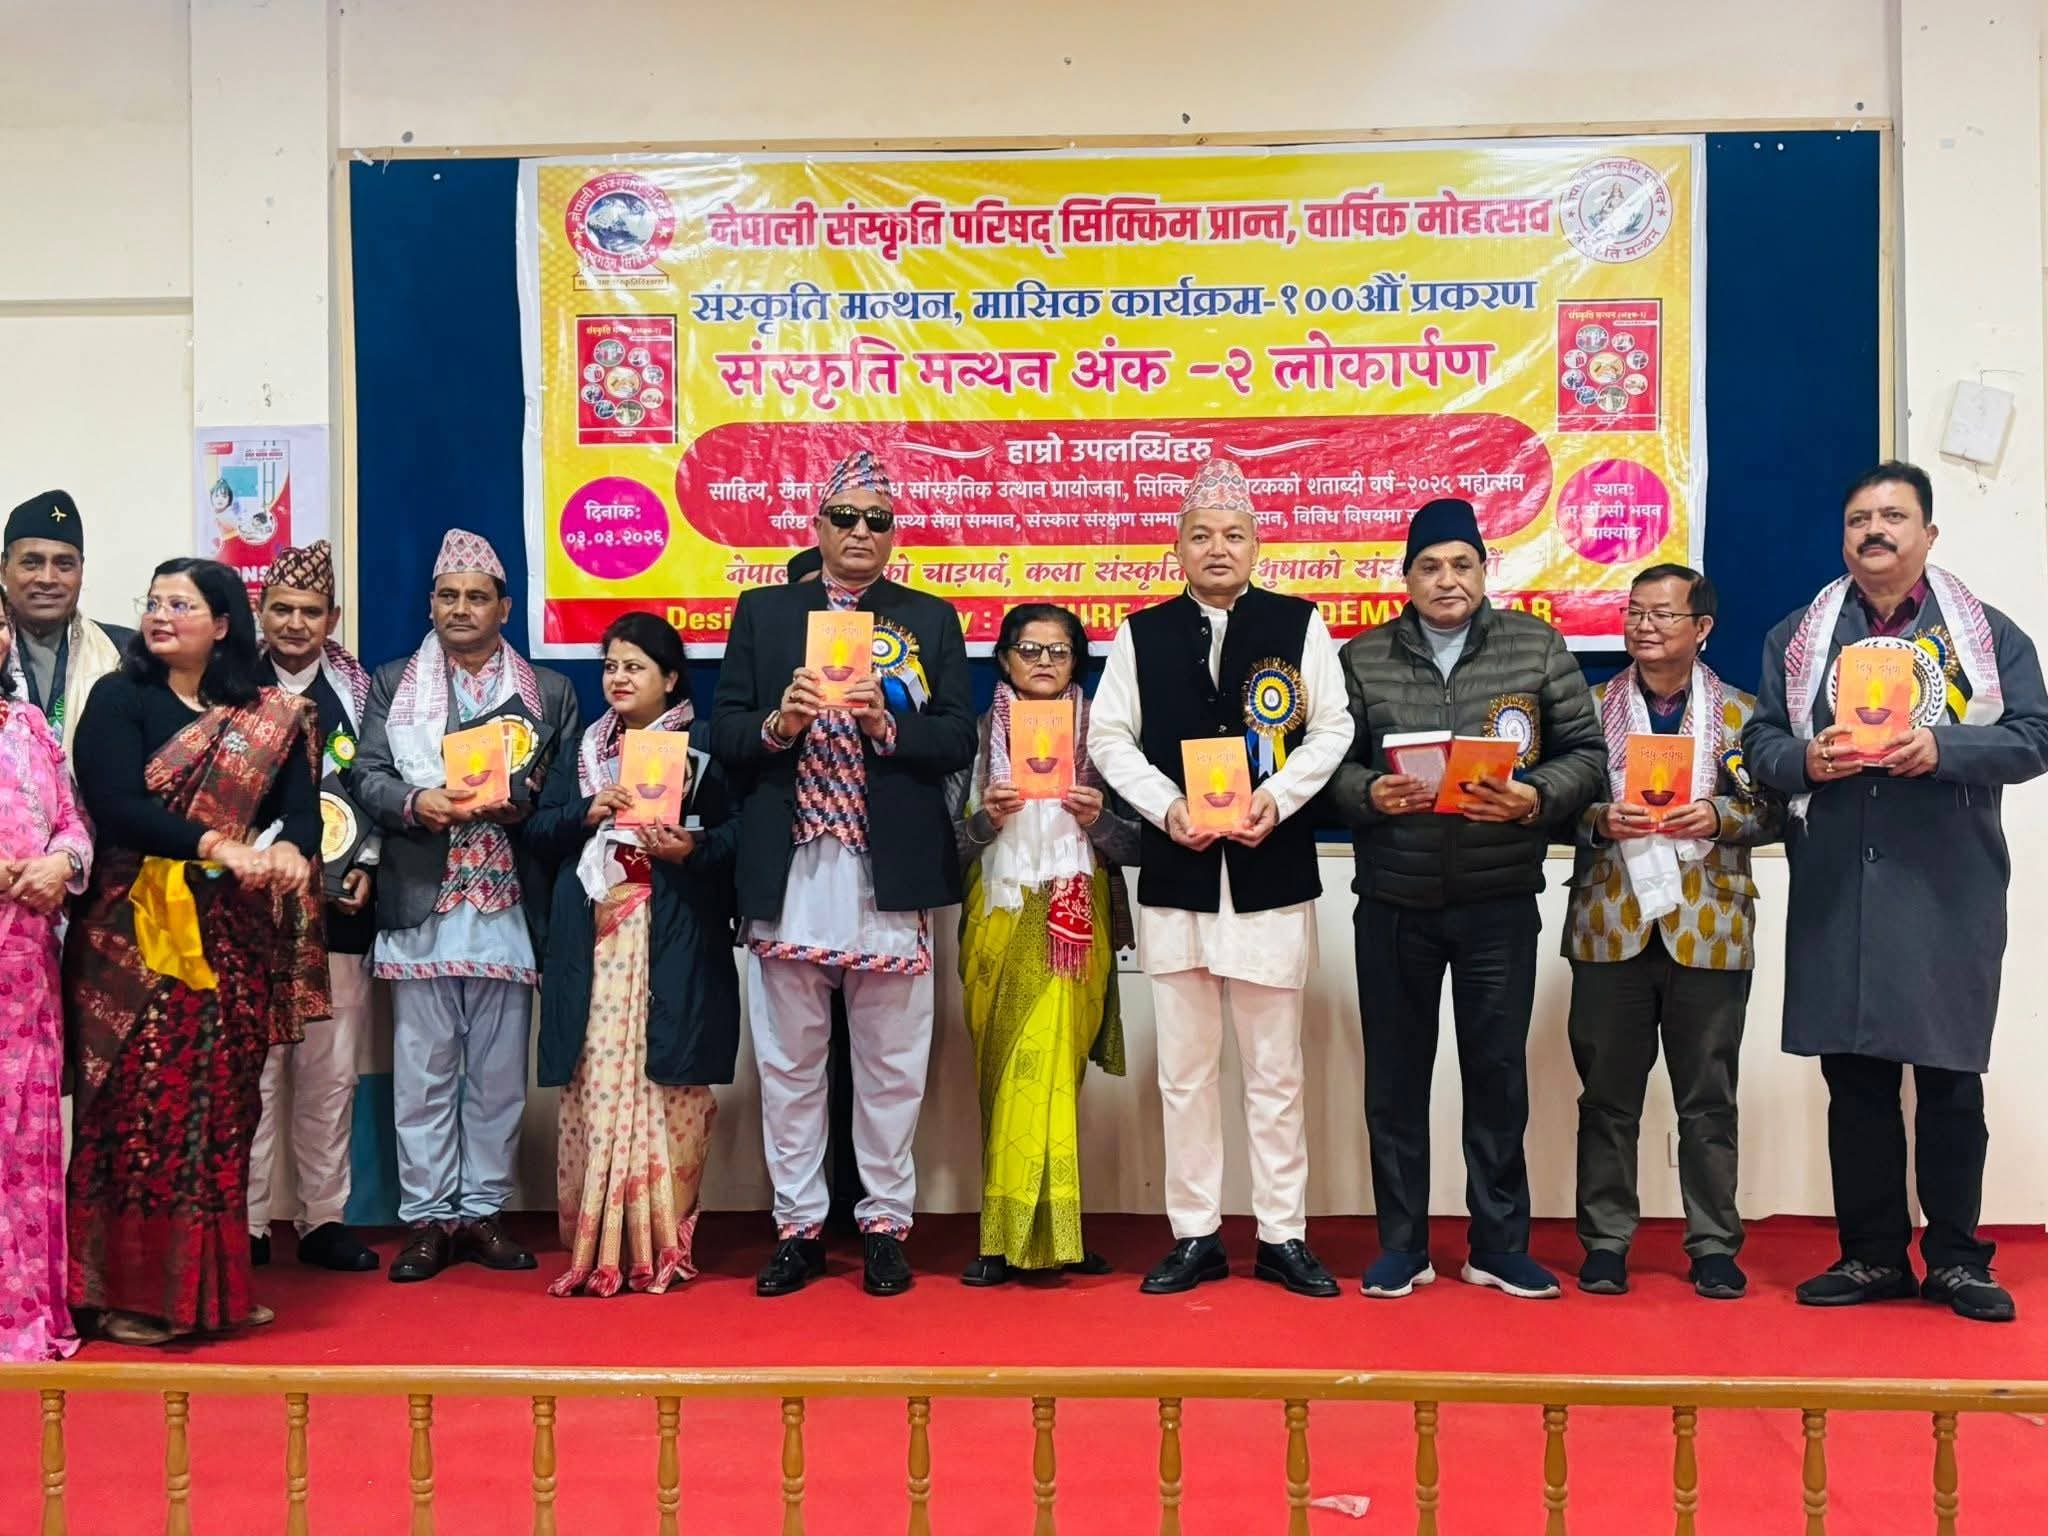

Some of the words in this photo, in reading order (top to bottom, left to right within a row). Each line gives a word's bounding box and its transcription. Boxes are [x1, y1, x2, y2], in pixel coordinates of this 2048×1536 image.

[707, 202, 815, 246] नेपाली
[824, 202, 944, 258] संस्कृति
[954, 201, 1055, 252] परिषद्
[1061, 193, 1202, 243] सिक्किम
[1207, 205, 1297, 245] प्रान्त,
[1305, 187, 1409, 238] वार्षिक
[692, 283, 830, 333] संस्कृति
[838, 290, 962, 327] मन्थन,
[972, 281, 1103, 320] मासिक
[1410, 281, 1538, 314] प्रकरण
[716, 337, 904, 410] संस्कृति
[915, 351, 1056, 396] मन्थन
[1073, 331, 1171, 395] अंक
[1269, 327, 1494, 390] लोकार्पण
[1006, 432, 1064, 464] हाम्रो
[708, 477, 773, 504] साहित्य,
[778, 477, 813, 500] खेल
[908, 474, 992, 505] सांस्कृतिक
[997, 480, 1048, 499] उत्थान
[1051, 475, 1129, 502] प्रायोजना,
[1135, 473, 1190, 498] सिक्कि
[1307, 472, 1363, 497] शताब्दी
[1458, 470, 1526, 493] महोत्सव
[768, 511, 808, 529] वरिष्ठ
[931, 509, 961, 530] सेवा
[966, 512, 1021, 532] सम्मान,
[1025, 509, 1079, 529] संस्कार
[1083, 508, 1136, 530] संरक्षण
[1140, 512, 1179, 528] सम्मा
[1294, 506, 1339, 526] विविध
[1343, 505, 1402, 525] विषयमा
[1629, 503, 1664, 518] भवन
[566, 529, 664, 547] ०३.०३.२०२६
[725, 552, 788, 586] नेपाल
[1025, 561, 1085, 583] कला
[1094, 554, 1187, 590] संस्कृति
[667, 605, 732, 632] Desi
